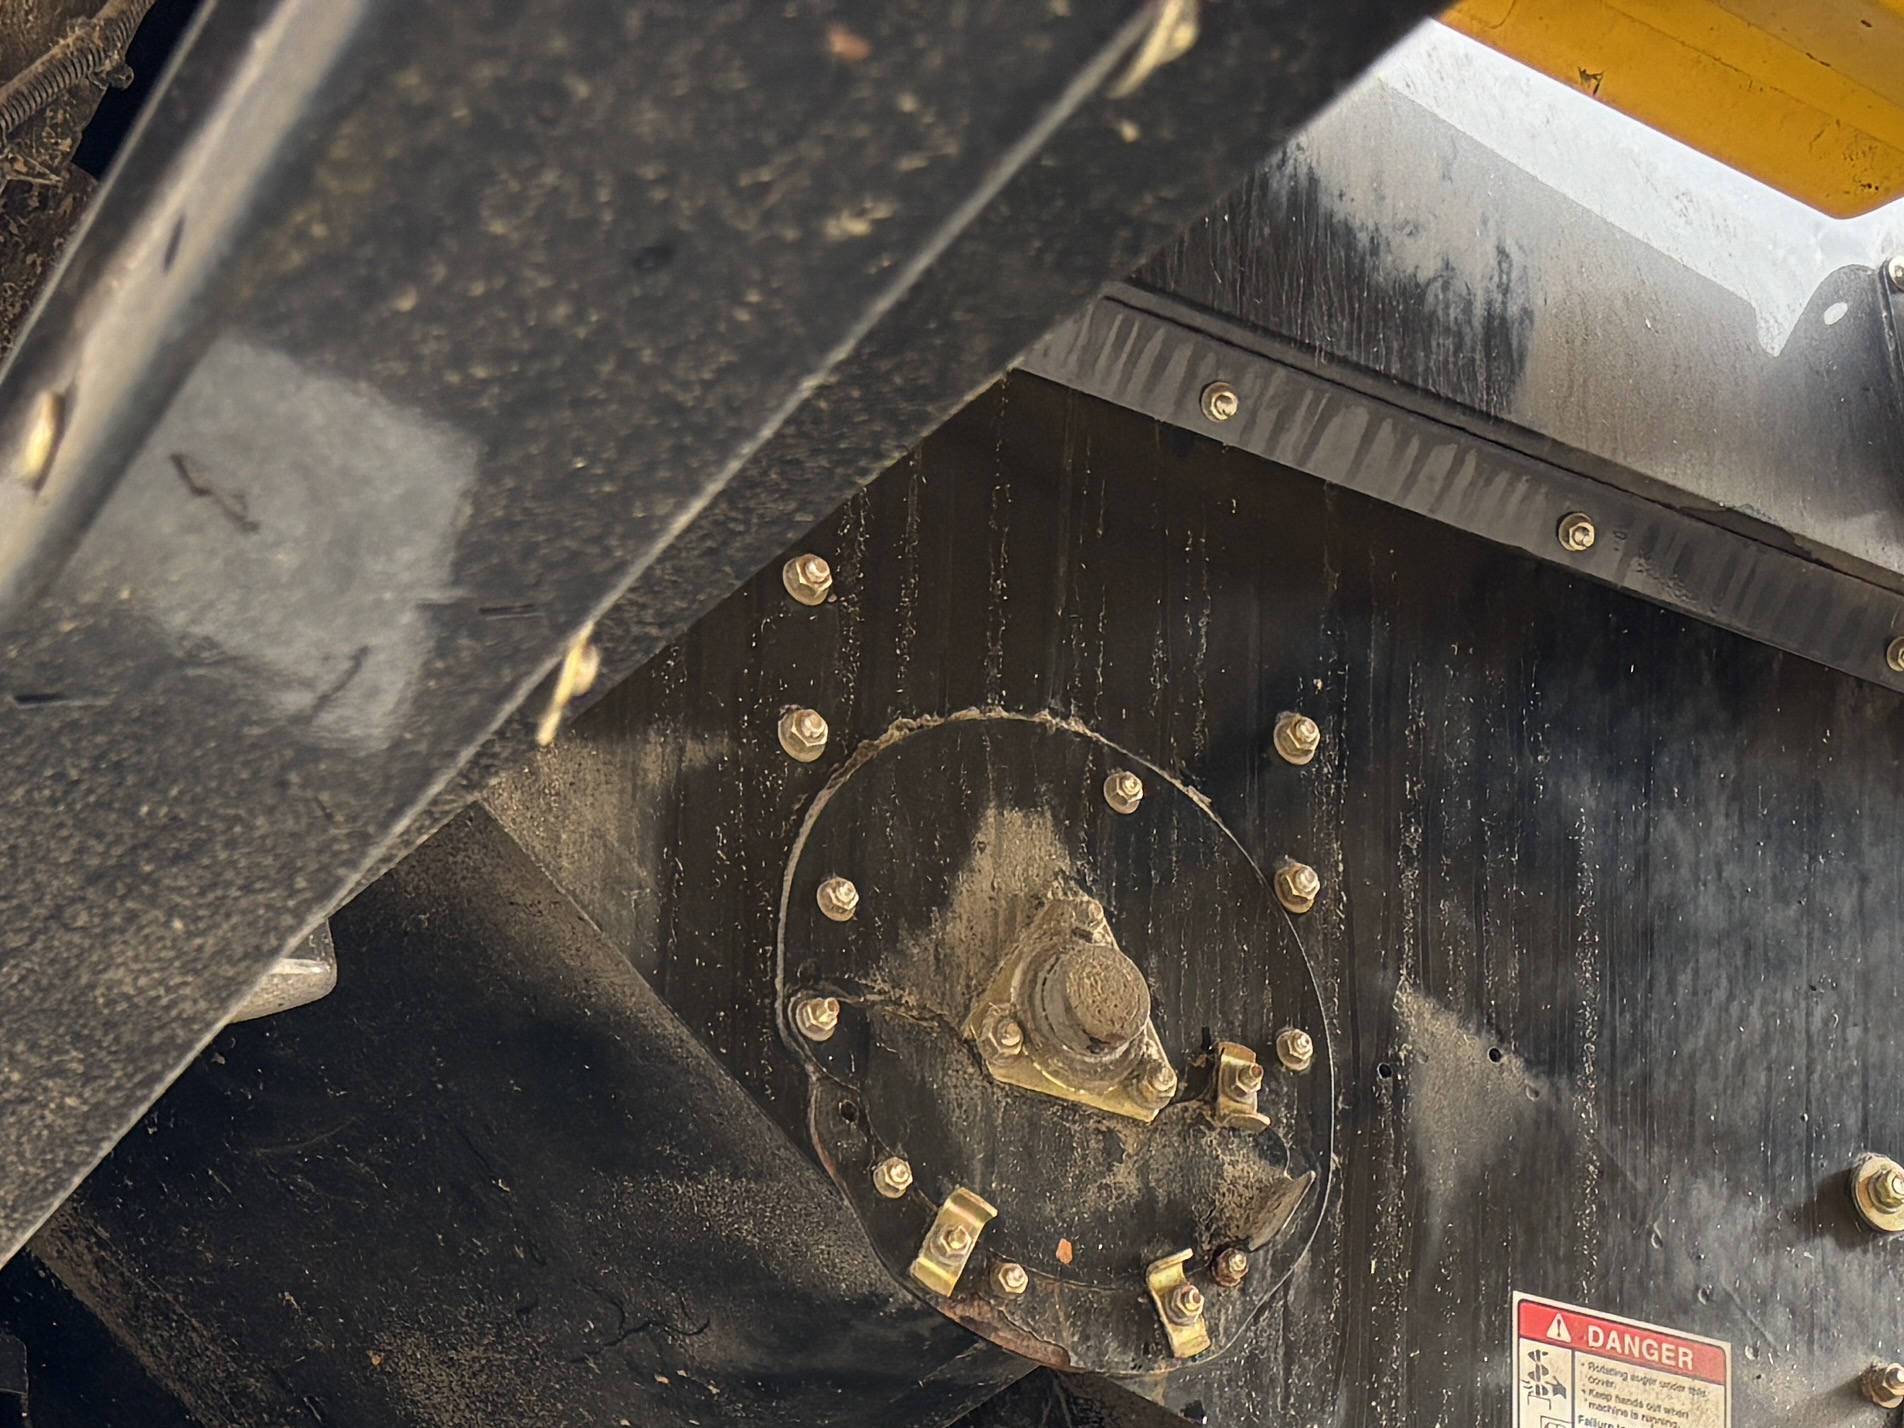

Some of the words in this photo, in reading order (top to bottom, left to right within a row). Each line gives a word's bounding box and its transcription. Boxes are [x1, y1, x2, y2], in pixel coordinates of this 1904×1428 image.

[1587, 1325, 1694, 1370] DANGER
[1588, 1388, 1612, 1403] Keep
[1615, 1394, 1643, 1408] hands
[1588, 1402, 1628, 1417] machine
